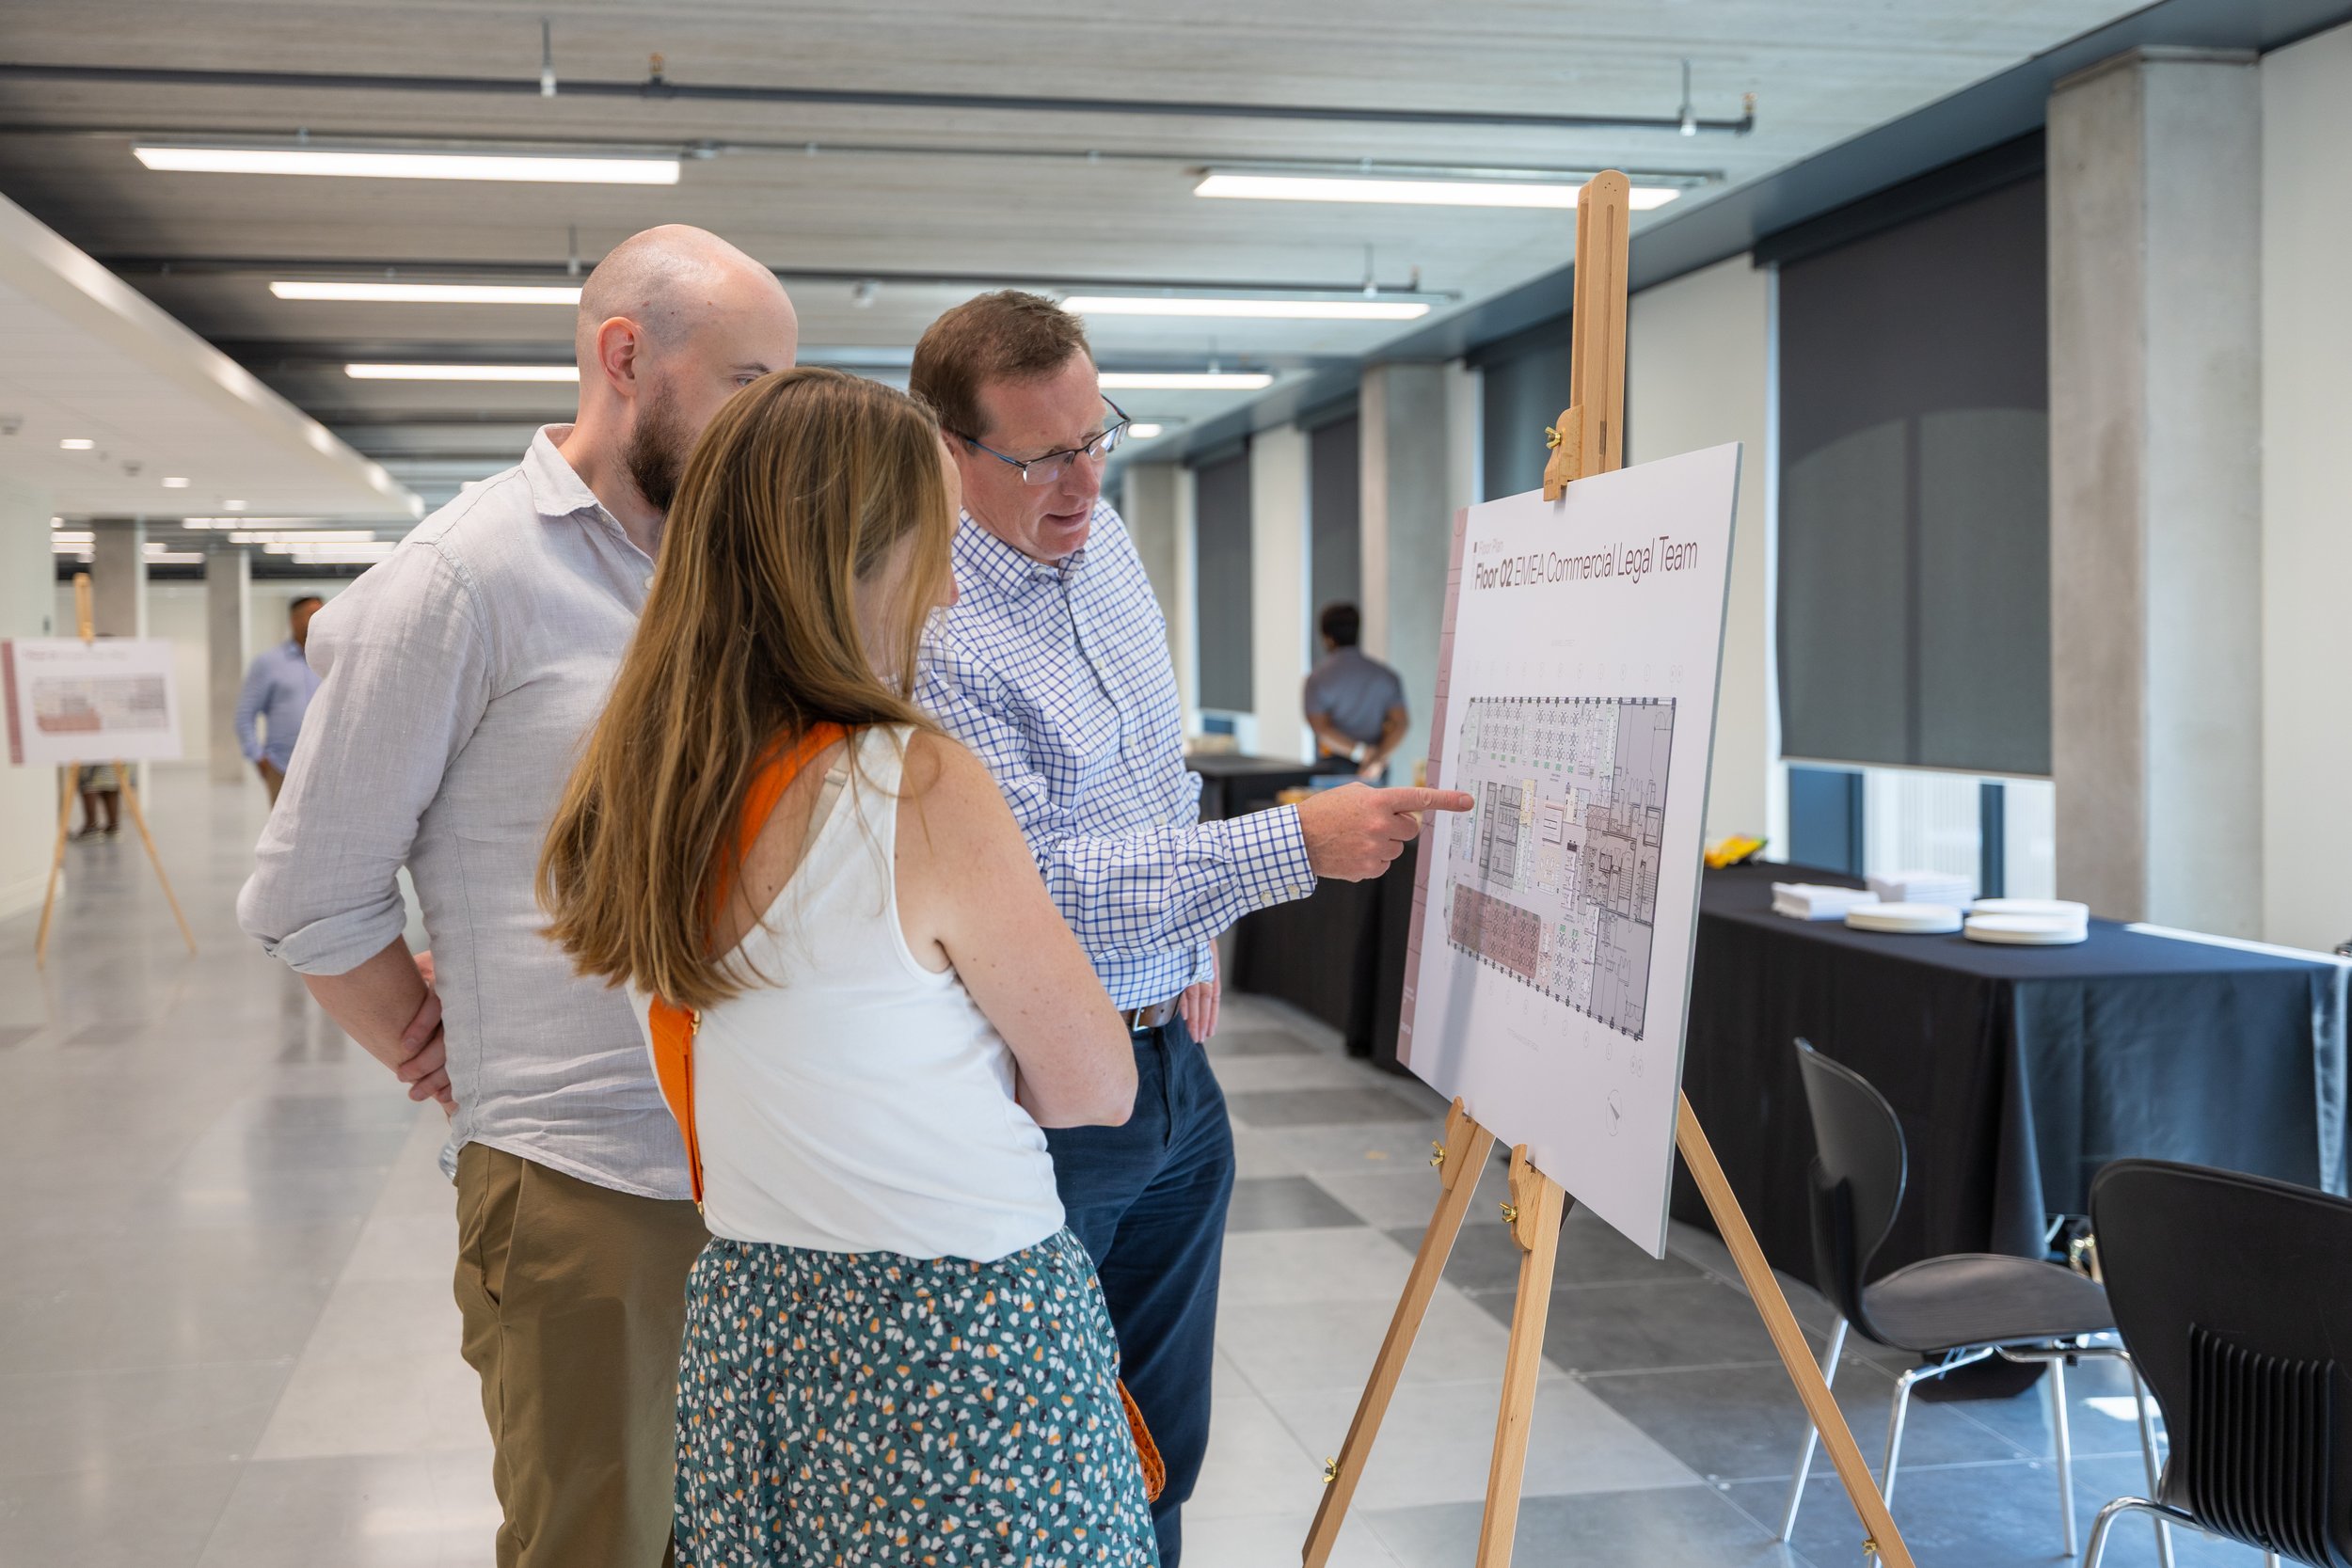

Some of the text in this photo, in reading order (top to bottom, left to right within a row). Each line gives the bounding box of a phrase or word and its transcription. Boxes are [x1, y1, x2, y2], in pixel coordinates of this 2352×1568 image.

[1474, 535, 1698, 591] Floor 02 EMEA Commercial Legal Team
